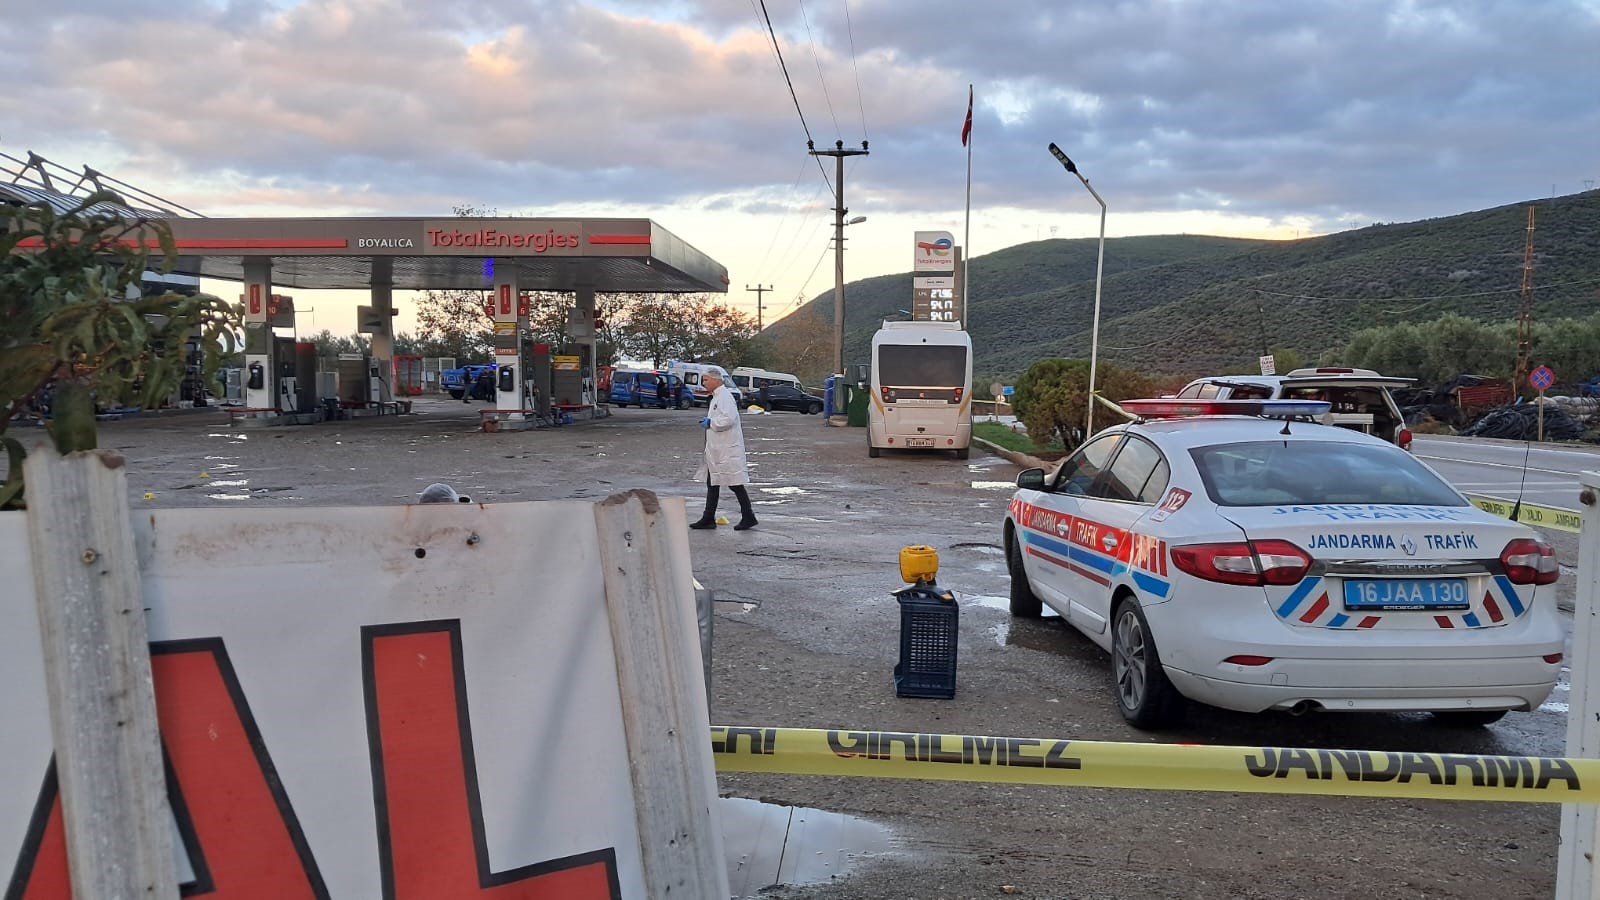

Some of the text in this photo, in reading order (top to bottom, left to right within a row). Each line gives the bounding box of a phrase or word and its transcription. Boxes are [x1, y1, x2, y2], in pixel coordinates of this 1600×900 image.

[358, 228, 578, 252] BOYALICA TotalEnergies
[1166, 491, 1185, 510] 112
[1272, 504, 1470, 515] JANDARMA
[1308, 531, 1479, 549] JANDARMA TRAFİK
[1358, 582, 1465, 602] 16 JAA 130
[1244, 746, 1582, 791] JANDARMA
